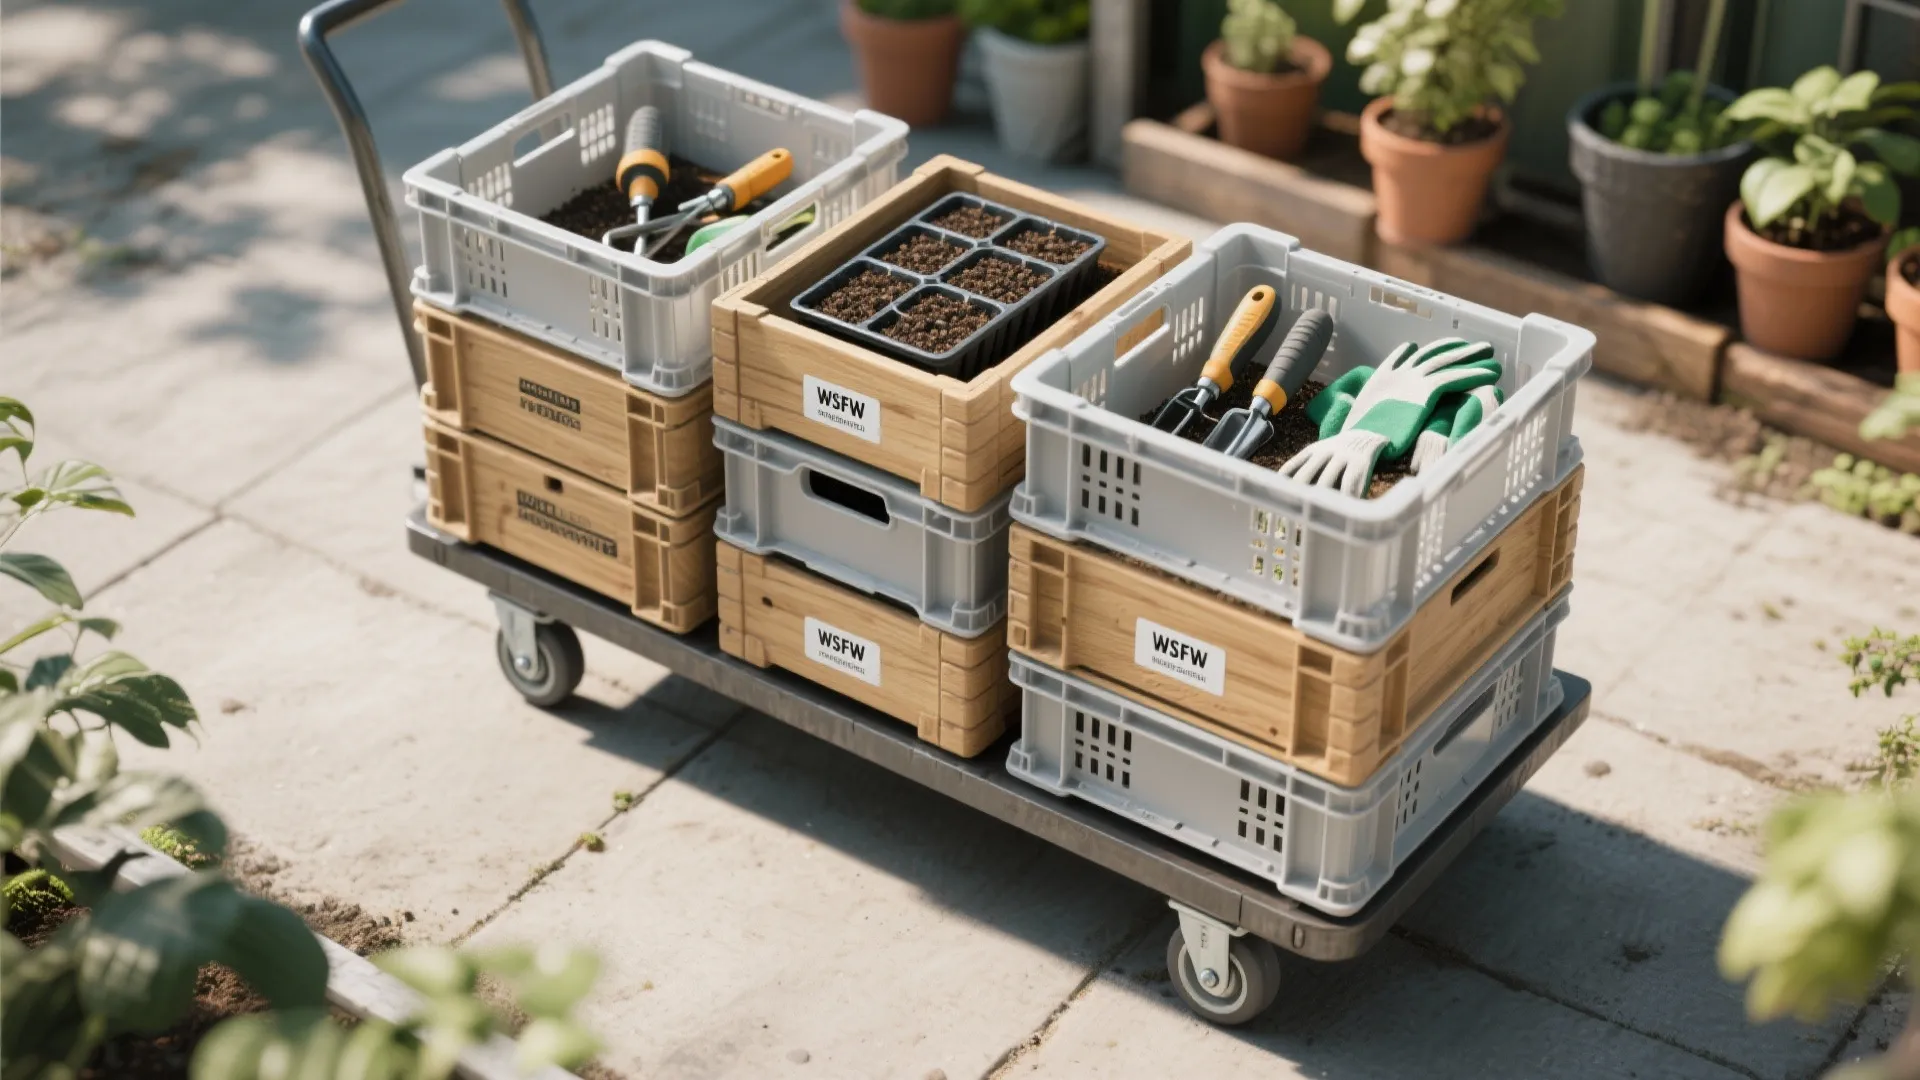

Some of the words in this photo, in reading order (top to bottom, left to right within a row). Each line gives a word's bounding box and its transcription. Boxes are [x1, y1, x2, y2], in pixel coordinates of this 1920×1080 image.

[817, 386, 865, 419] WSFW
[818, 628, 865, 662] WSFW
[1153, 631, 1208, 669] WSFW
